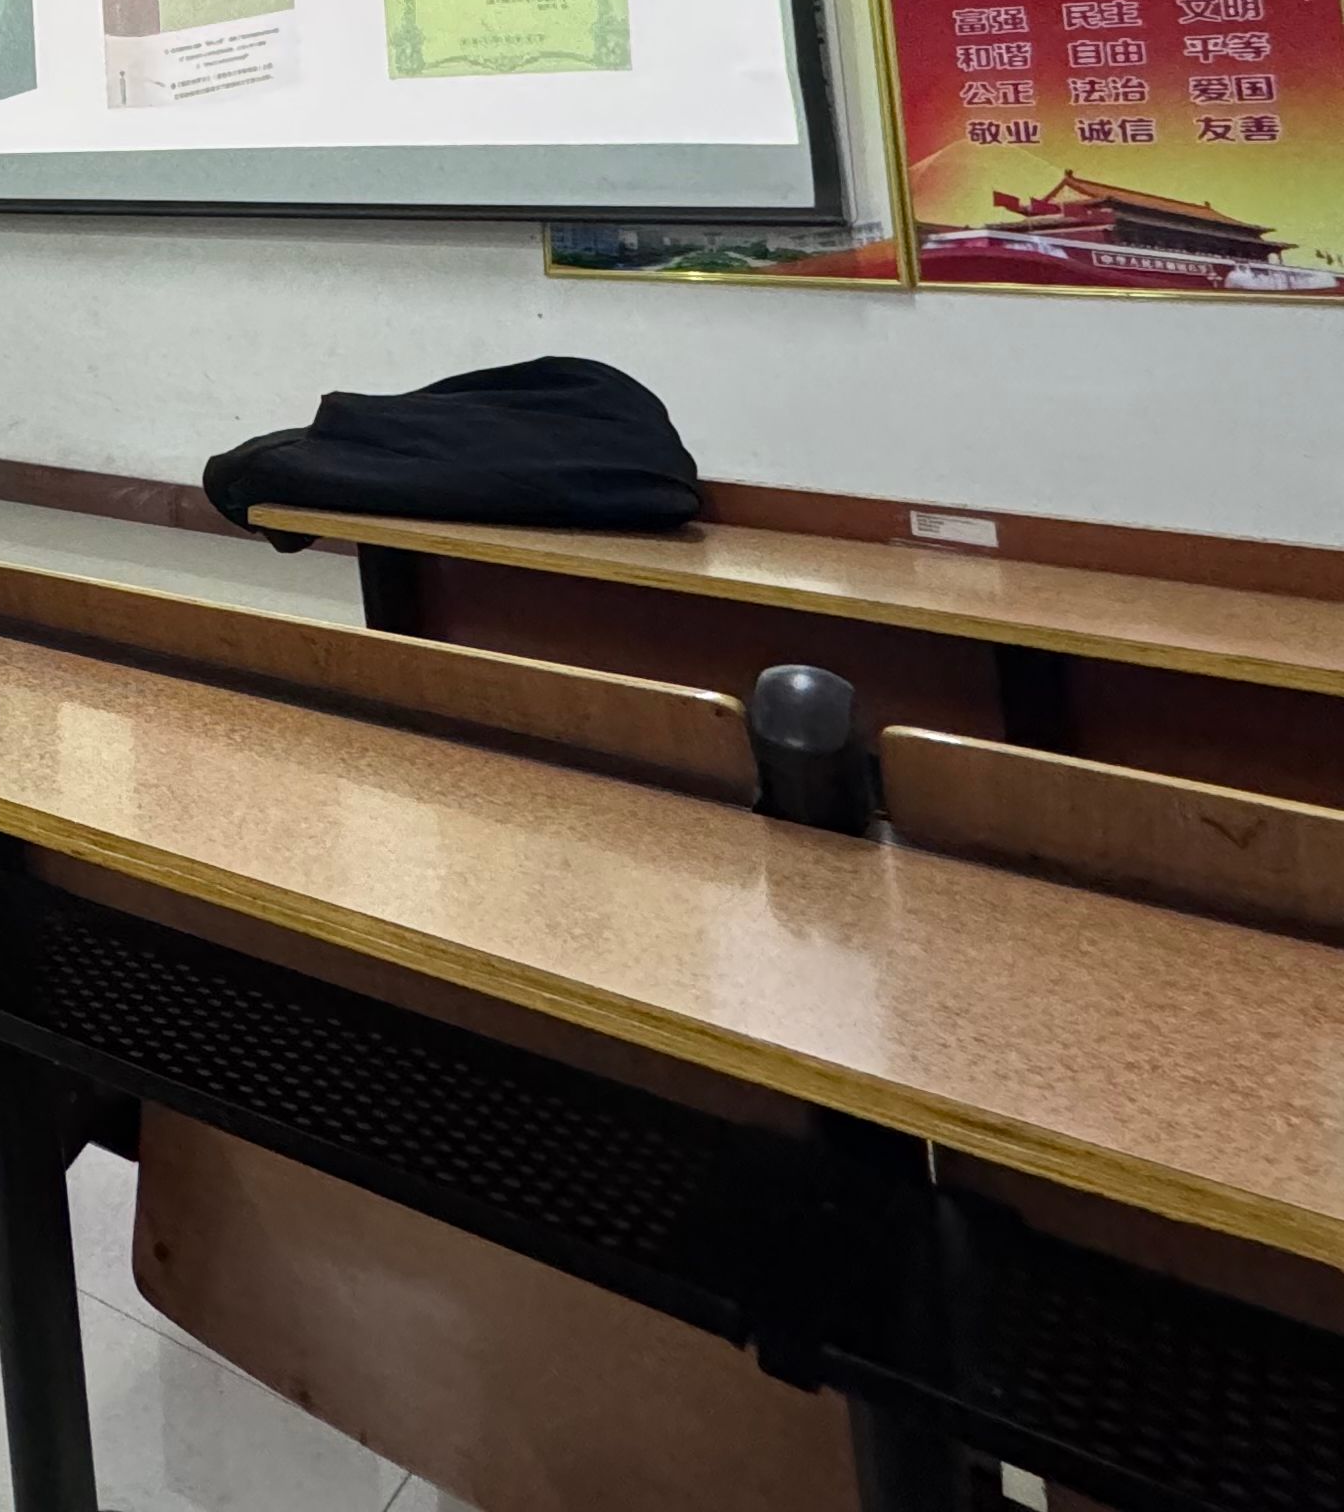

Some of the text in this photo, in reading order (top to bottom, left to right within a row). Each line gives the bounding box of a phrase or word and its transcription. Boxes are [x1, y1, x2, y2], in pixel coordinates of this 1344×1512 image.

[953, 6, 1029, 35] 富强
[1062, 0, 1143, 30] 民主
[957, 32, 1270, 71] 和谐 自由 平等
[959, 74, 1278, 107] 公正 法治 爱国
[966, 114, 1281, 145] 敬业 诚信 友善
